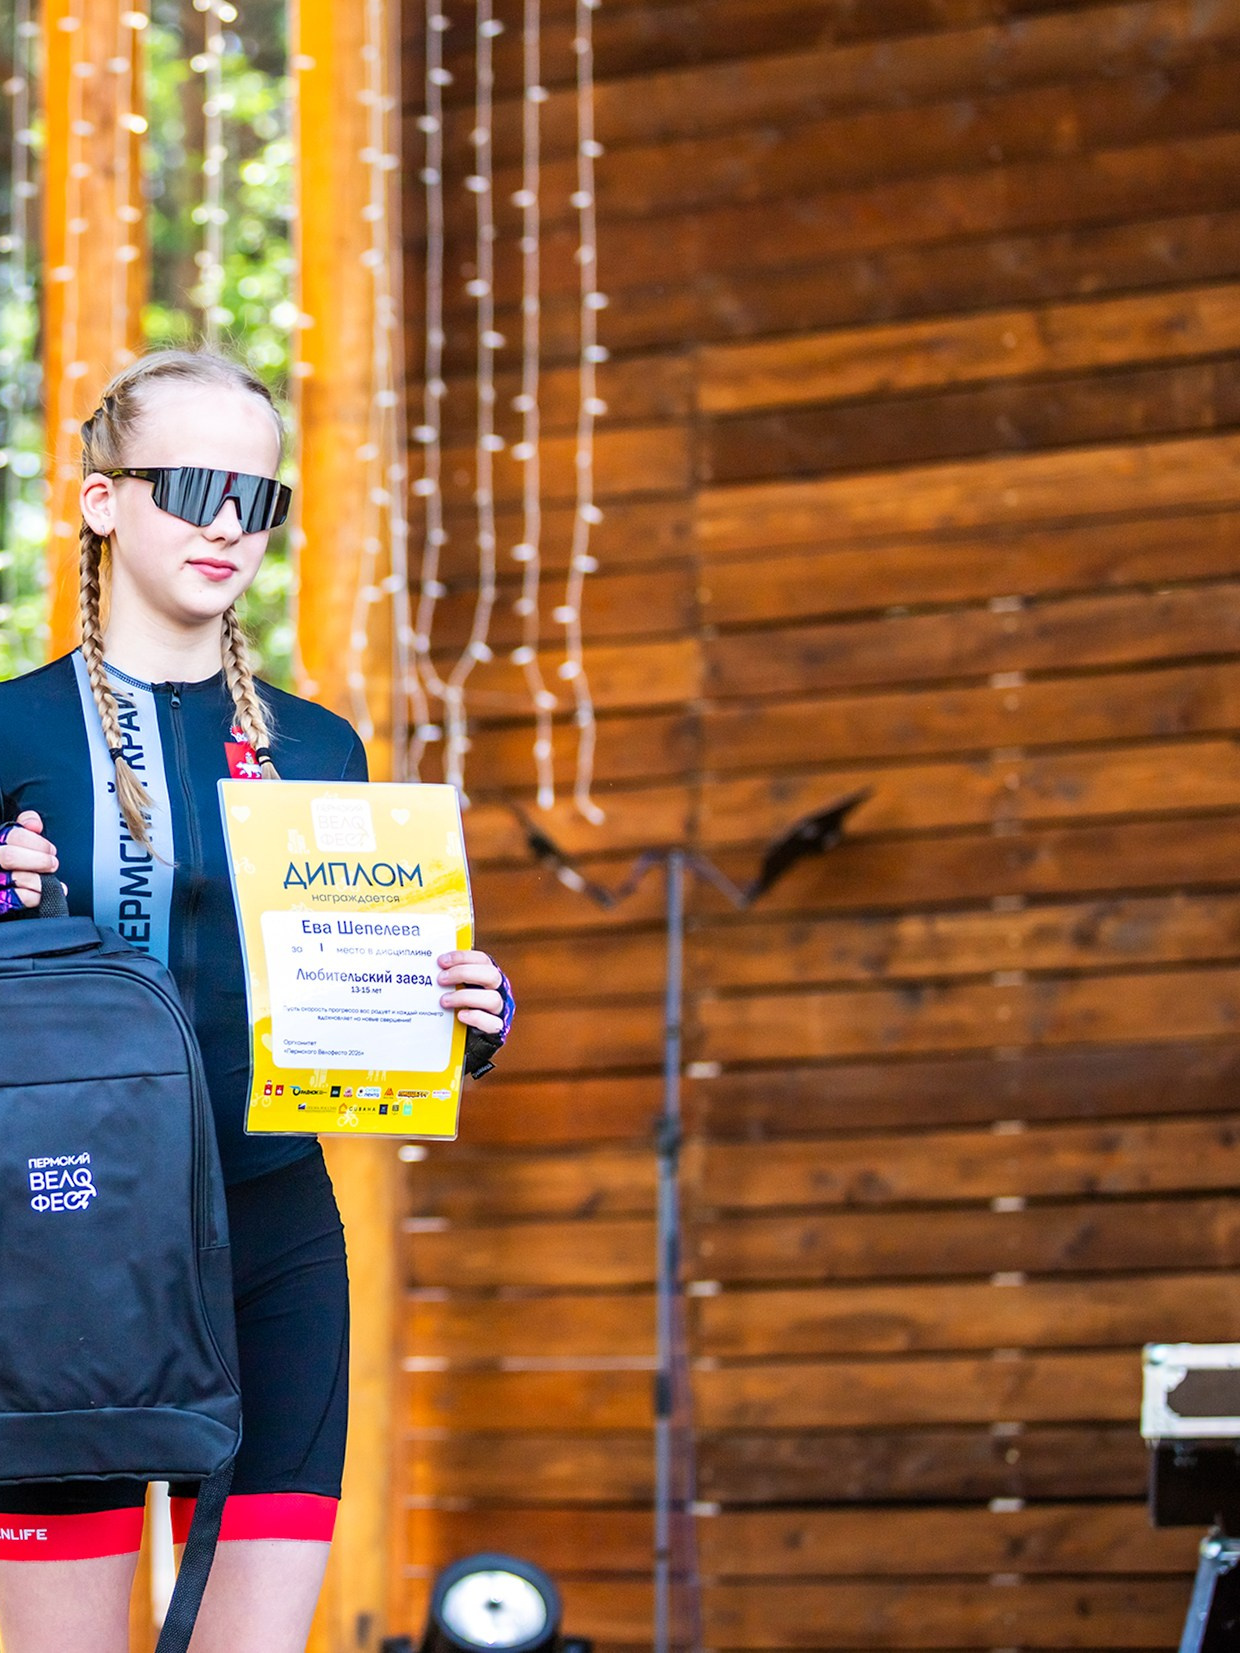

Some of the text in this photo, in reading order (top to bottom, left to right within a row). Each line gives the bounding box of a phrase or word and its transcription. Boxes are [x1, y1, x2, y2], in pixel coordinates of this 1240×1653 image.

[283, 861, 423, 889] ДИПЛОМ
[311, 893, 401, 904] награждается
[301, 919, 421, 936] Ева Шепелева
[291, 945, 303, 953] за
[375, 948, 433, 957] дисциплине
[296, 968, 433, 986] Любительский заезд
[350, 985, 371, 994] 13-15
[28, 1152, 91, 1169] ПЕРМСКИЙ
[30, 1190, 94, 1213] ФЕСТ
